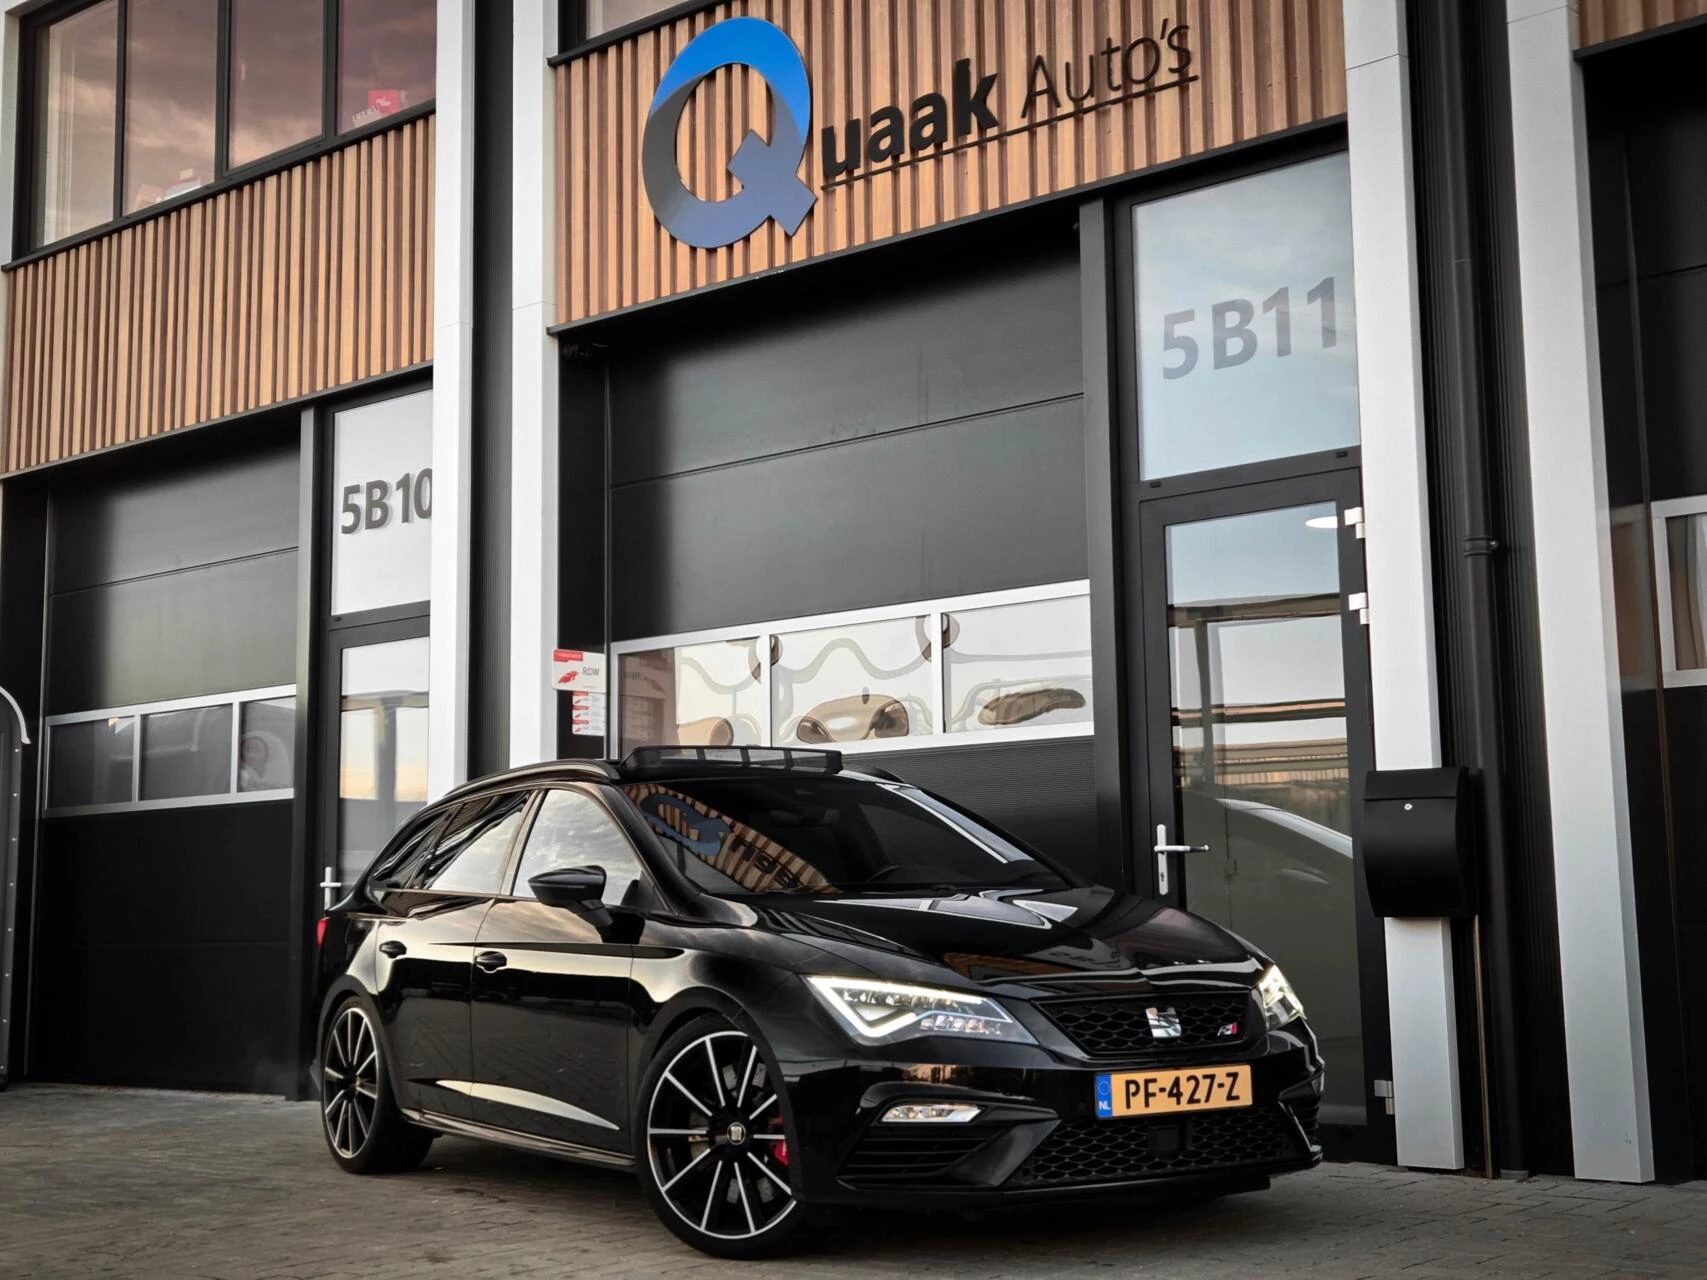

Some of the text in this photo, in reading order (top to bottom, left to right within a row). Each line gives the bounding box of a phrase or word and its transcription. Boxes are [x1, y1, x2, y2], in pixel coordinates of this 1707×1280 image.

[642, 16, 1193, 250] Quaak Auto's
[1162, 276, 1337, 380] 5B11
[341, 467, 433, 535] 5B10
[1098, 1100, 1111, 1111] NL
[1124, 1071, 1240, 1109] PF-427-Z
